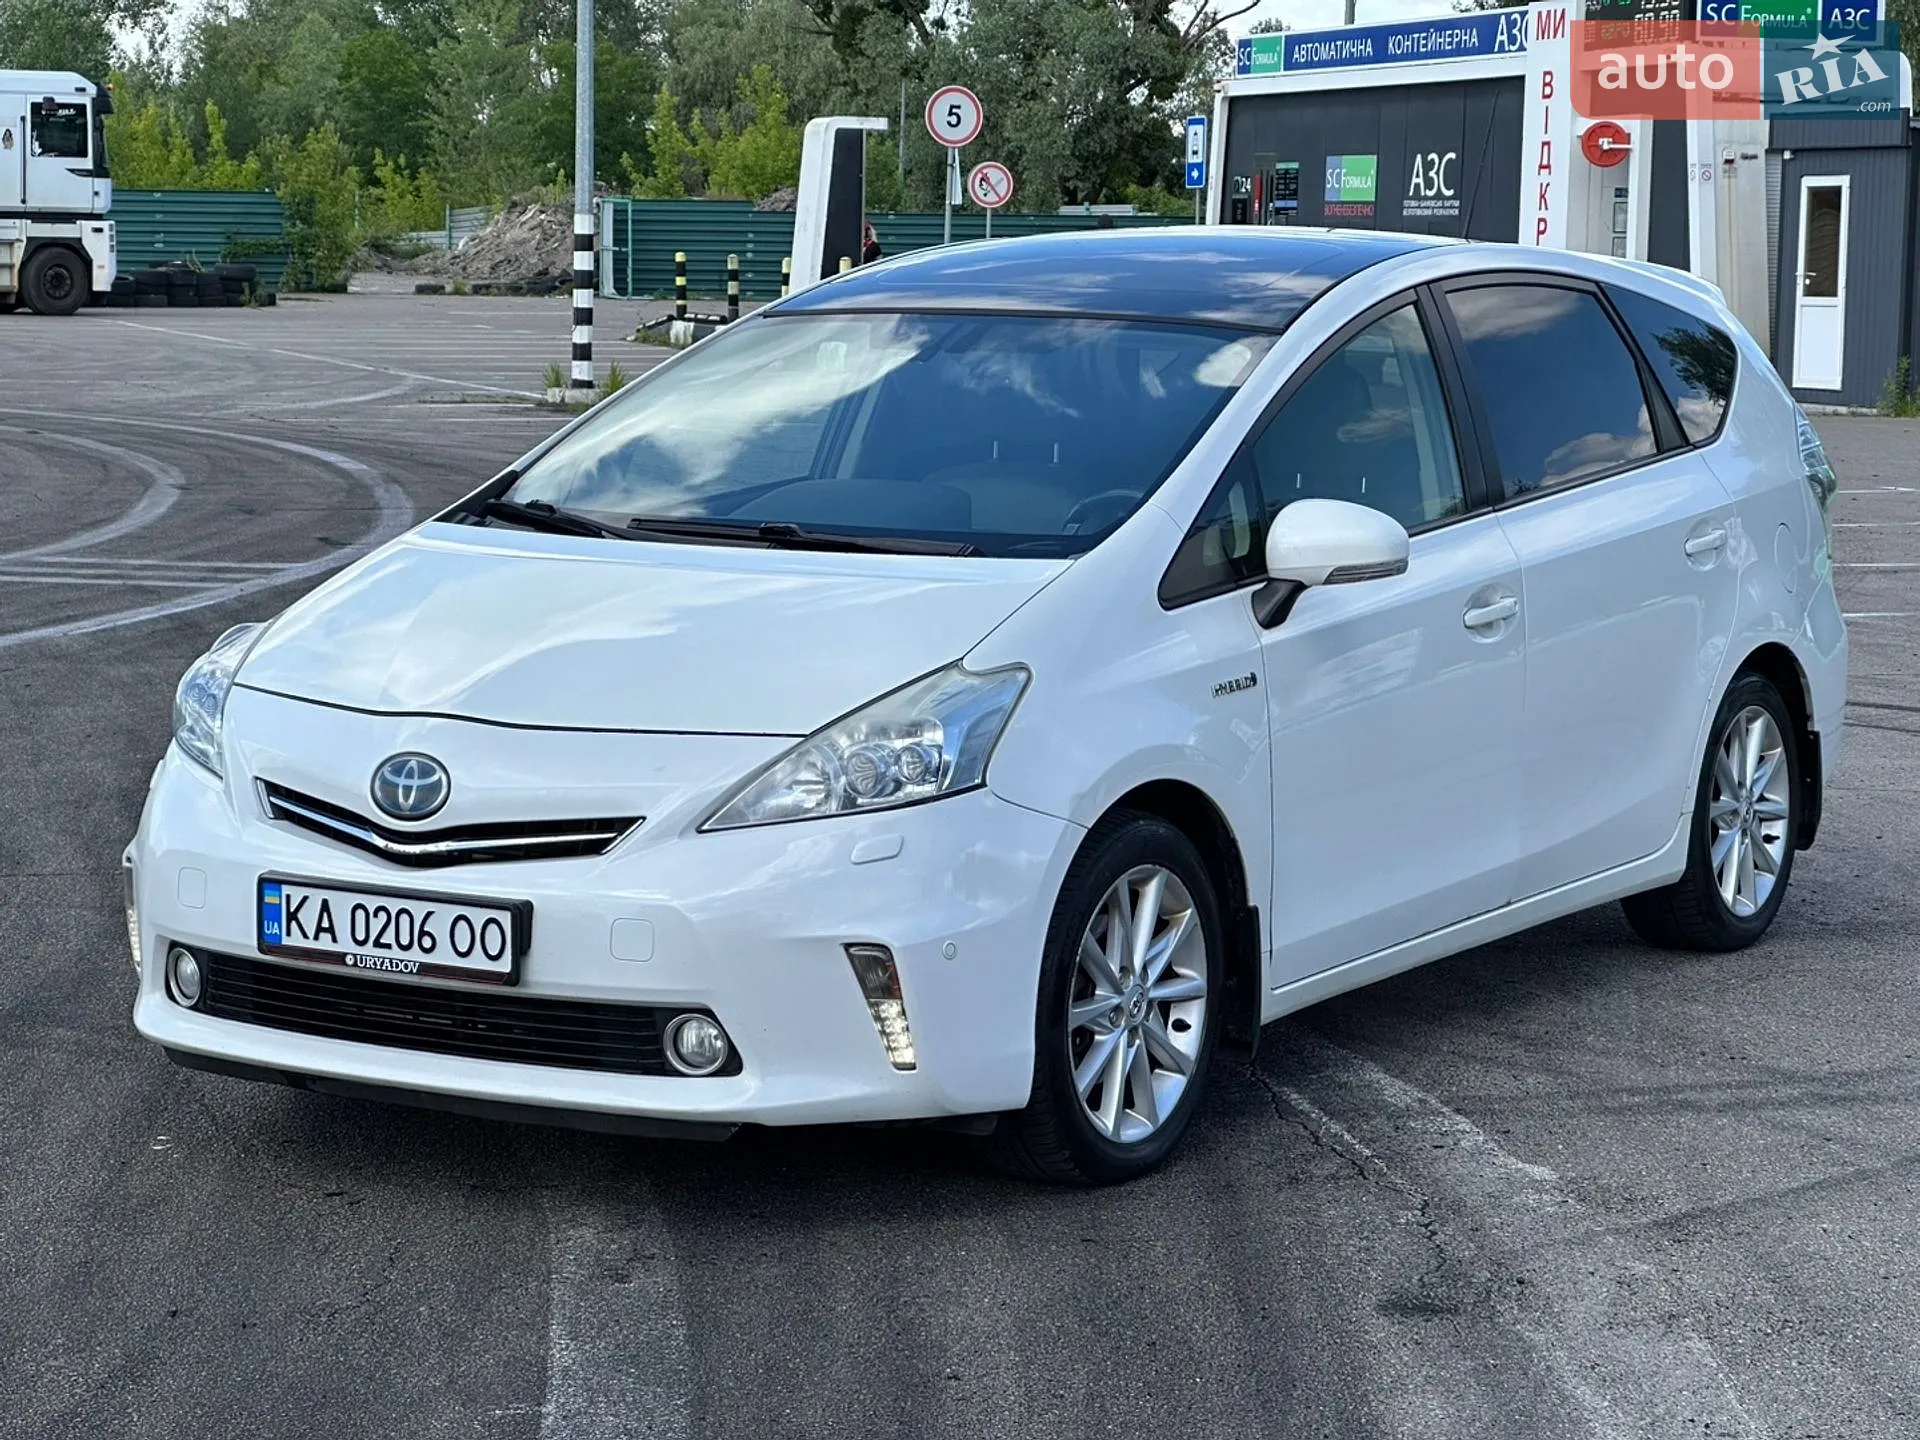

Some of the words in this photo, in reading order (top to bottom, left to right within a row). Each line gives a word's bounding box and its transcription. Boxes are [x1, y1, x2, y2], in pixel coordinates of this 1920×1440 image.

[1536, 8, 1567, 41] МИ
[1705, 3, 1736, 26] SC
[1829, 8, 1871, 31] АЗС
[1238, 47, 1250, 66] SC
[1292, 38, 1373, 63] АВТОМАТИЧНА
[1388, 28, 1479, 55] КОНТЕЙНЕРНА
[946, 104, 962, 128] 5
[1326, 168, 1340, 188] SC
[1409, 152, 1456, 197] АЗС
[264, 921, 280, 935] UA
[285, 894, 338, 943] KA
[351, 903, 437, 954] 0206
[357, 956, 419, 974] URYADOV
